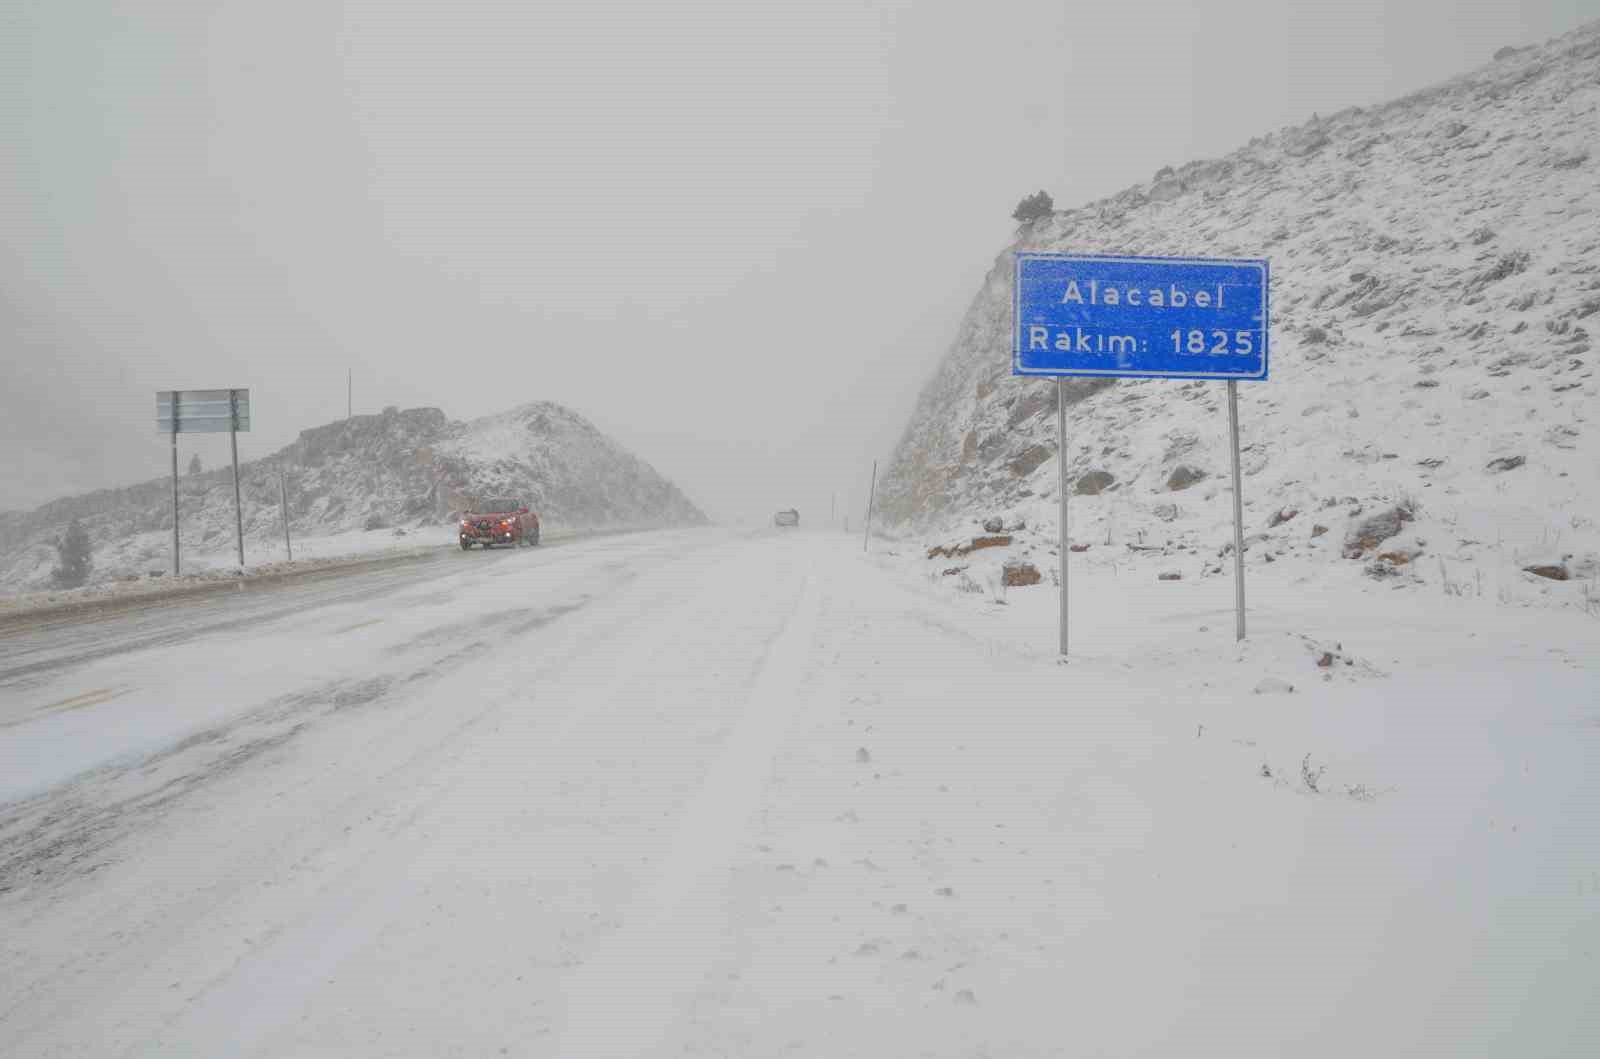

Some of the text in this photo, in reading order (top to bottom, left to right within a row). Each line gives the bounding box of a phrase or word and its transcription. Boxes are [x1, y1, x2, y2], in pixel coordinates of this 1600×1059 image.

[1061, 280, 1225, 308] Alacabel
[1028, 326, 1254, 356] Rakım: 1825
